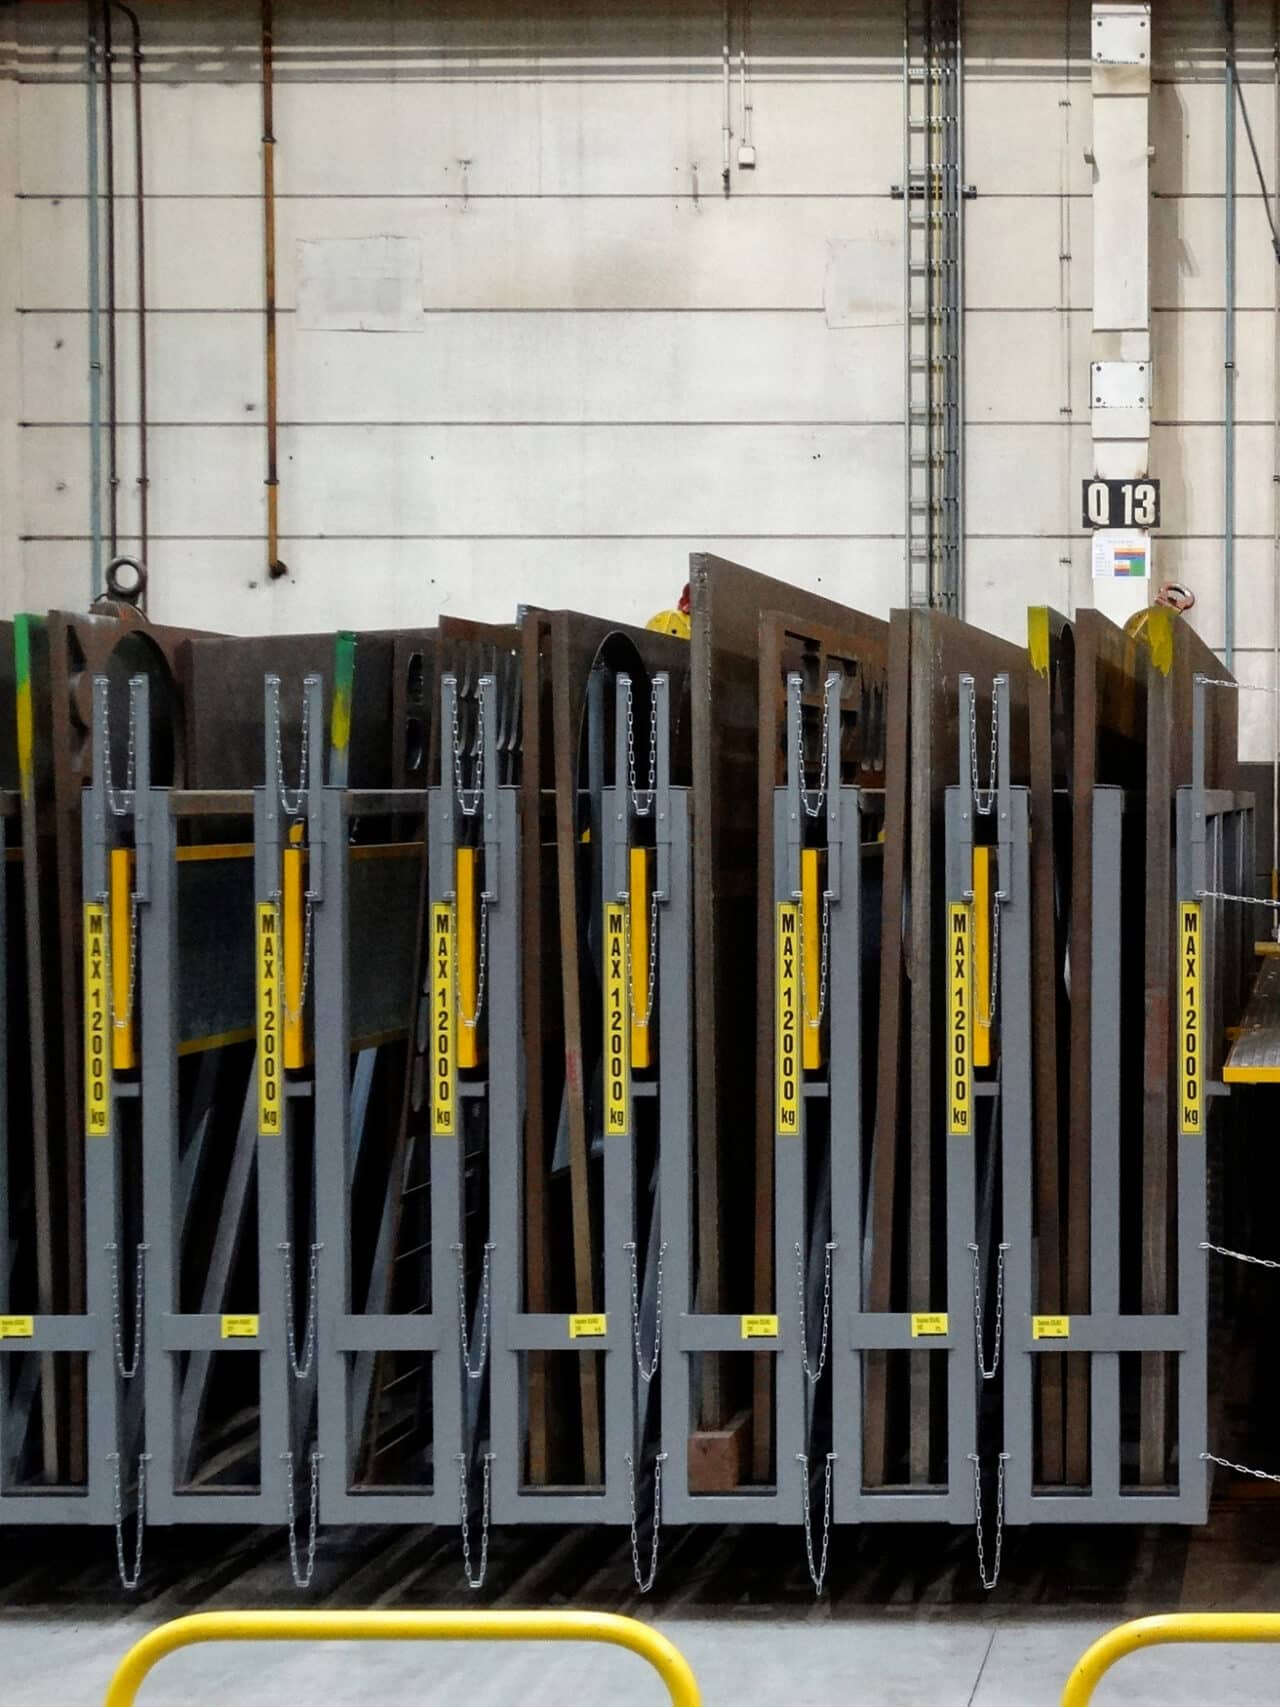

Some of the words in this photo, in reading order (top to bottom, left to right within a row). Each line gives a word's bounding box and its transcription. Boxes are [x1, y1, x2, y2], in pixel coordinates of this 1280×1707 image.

[1088, 483, 1110, 525] Q
[1121, 484, 1156, 525] 13
[90, 914, 103, 979] MAX
[262, 913, 275, 979] MAX
[436, 914, 449, 979] MAX
[609, 914, 622, 979] MAX
[782, 913, 795, 978] MAX
[953, 913, 966, 979] MAX
[1184, 912, 1197, 978] MAX
[92, 988, 103, 1102] 12000
[264, 988, 276, 1101] 12000
[438, 987, 449, 1101] 12000
[611, 987, 623, 1101] 12000
[783, 987, 794, 1101] 12000
[954, 987, 966, 1101] 12000
[1185, 986, 1197, 1100] 12000
[91, 1108, 105, 1128] kg
[263, 1107, 277, 1127] kg
[436, 1107, 451, 1127] kg
[610, 1107, 624, 1127] kg
[781, 1107, 795, 1127] kg
[953, 1107, 967, 1127] kg
[1184, 1106, 1199, 1126] kg
